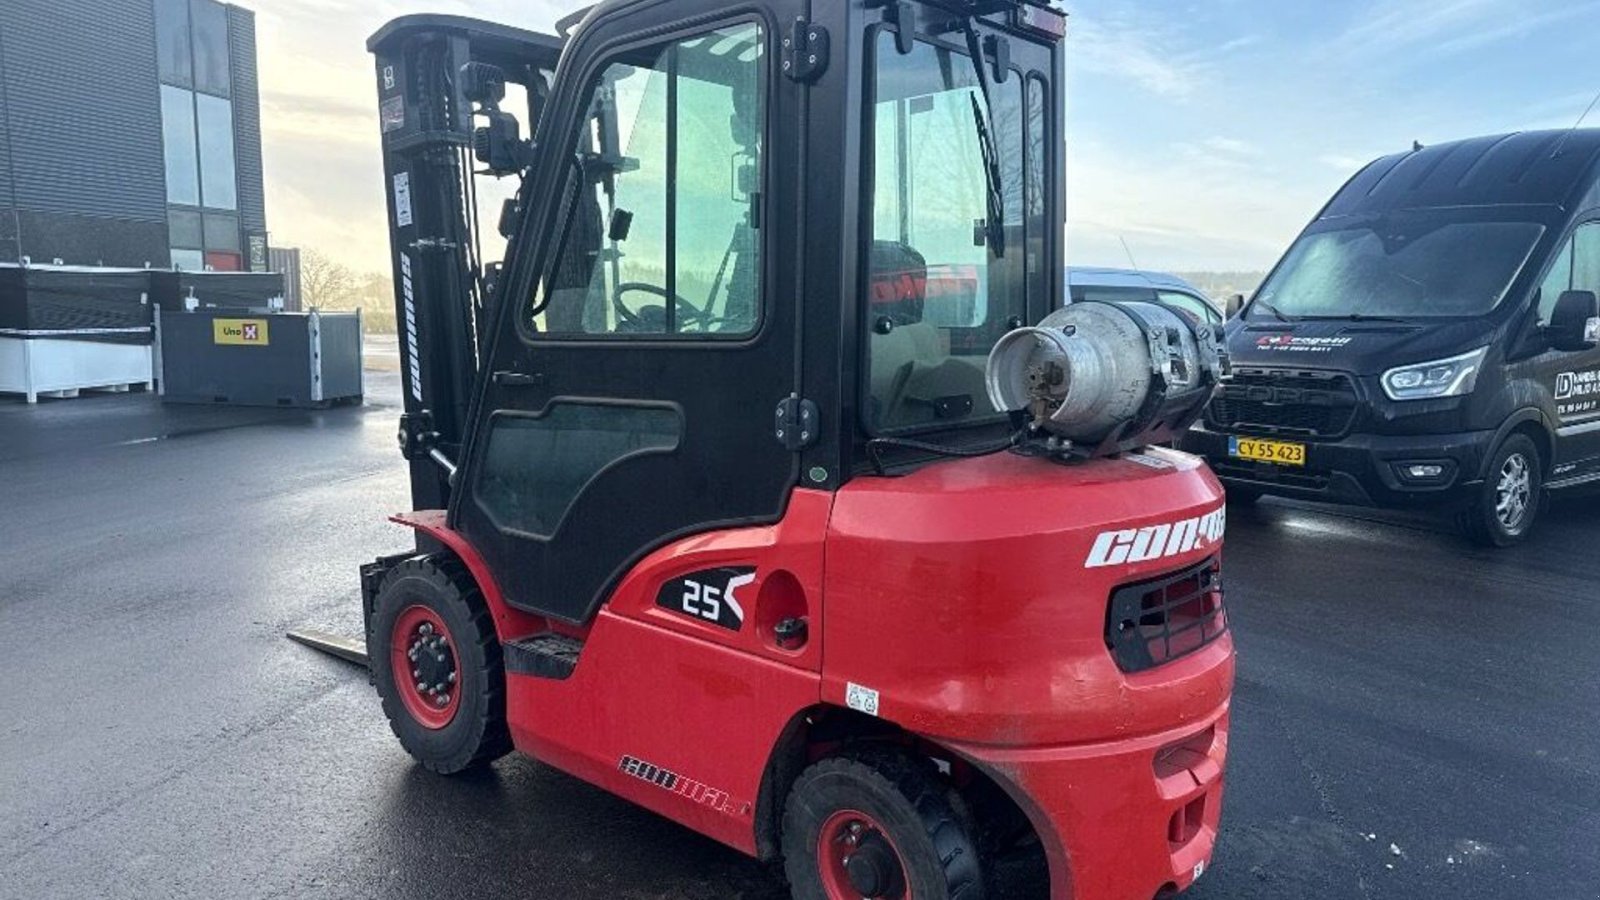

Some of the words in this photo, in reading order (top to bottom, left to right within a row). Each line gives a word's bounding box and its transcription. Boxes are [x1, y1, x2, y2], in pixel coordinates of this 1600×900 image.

[223, 326, 241, 336] Uno
[1238, 442, 1254, 456] CY
[1259, 444, 1273, 458] 55
[1278, 445, 1301, 461] 423
[683, 579, 720, 620] 25
